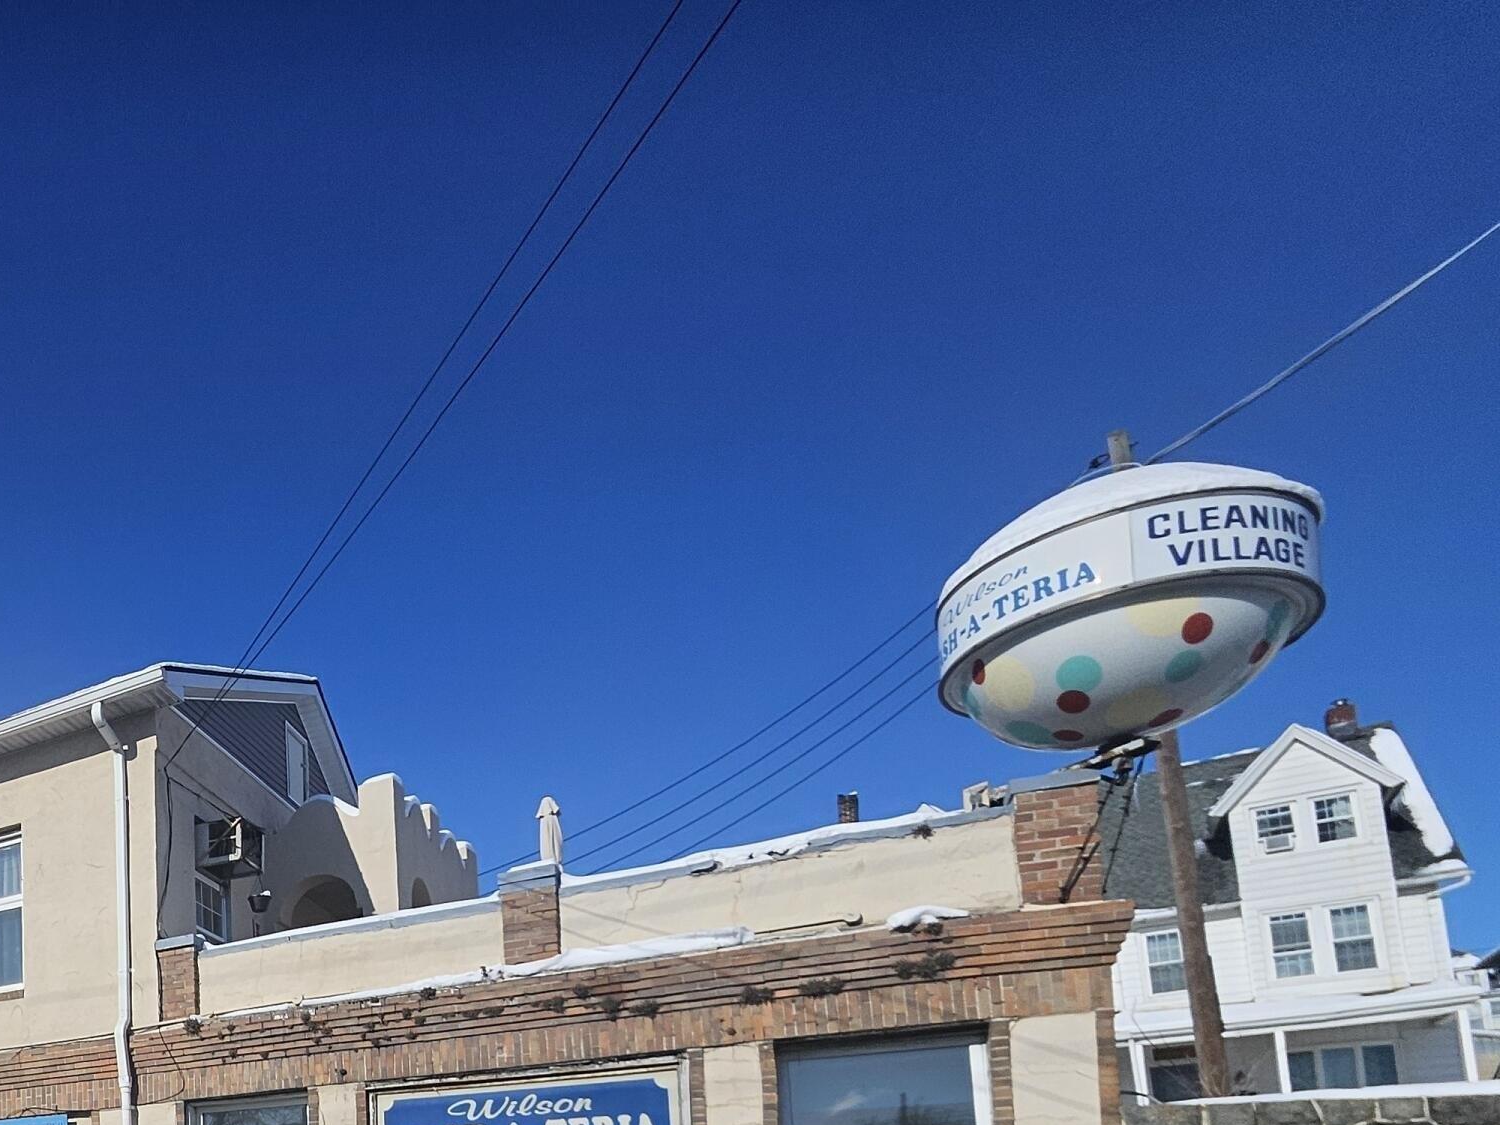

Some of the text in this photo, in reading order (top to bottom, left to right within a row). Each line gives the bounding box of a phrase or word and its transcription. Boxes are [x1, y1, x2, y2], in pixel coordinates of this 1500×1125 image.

[1147, 504, 1309, 541] CLEANING
[1167, 538, 1305, 568] VILLAGE
[940, 561, 1097, 665] SH-A-TERIA
[447, 1093, 593, 1121] Wilson
